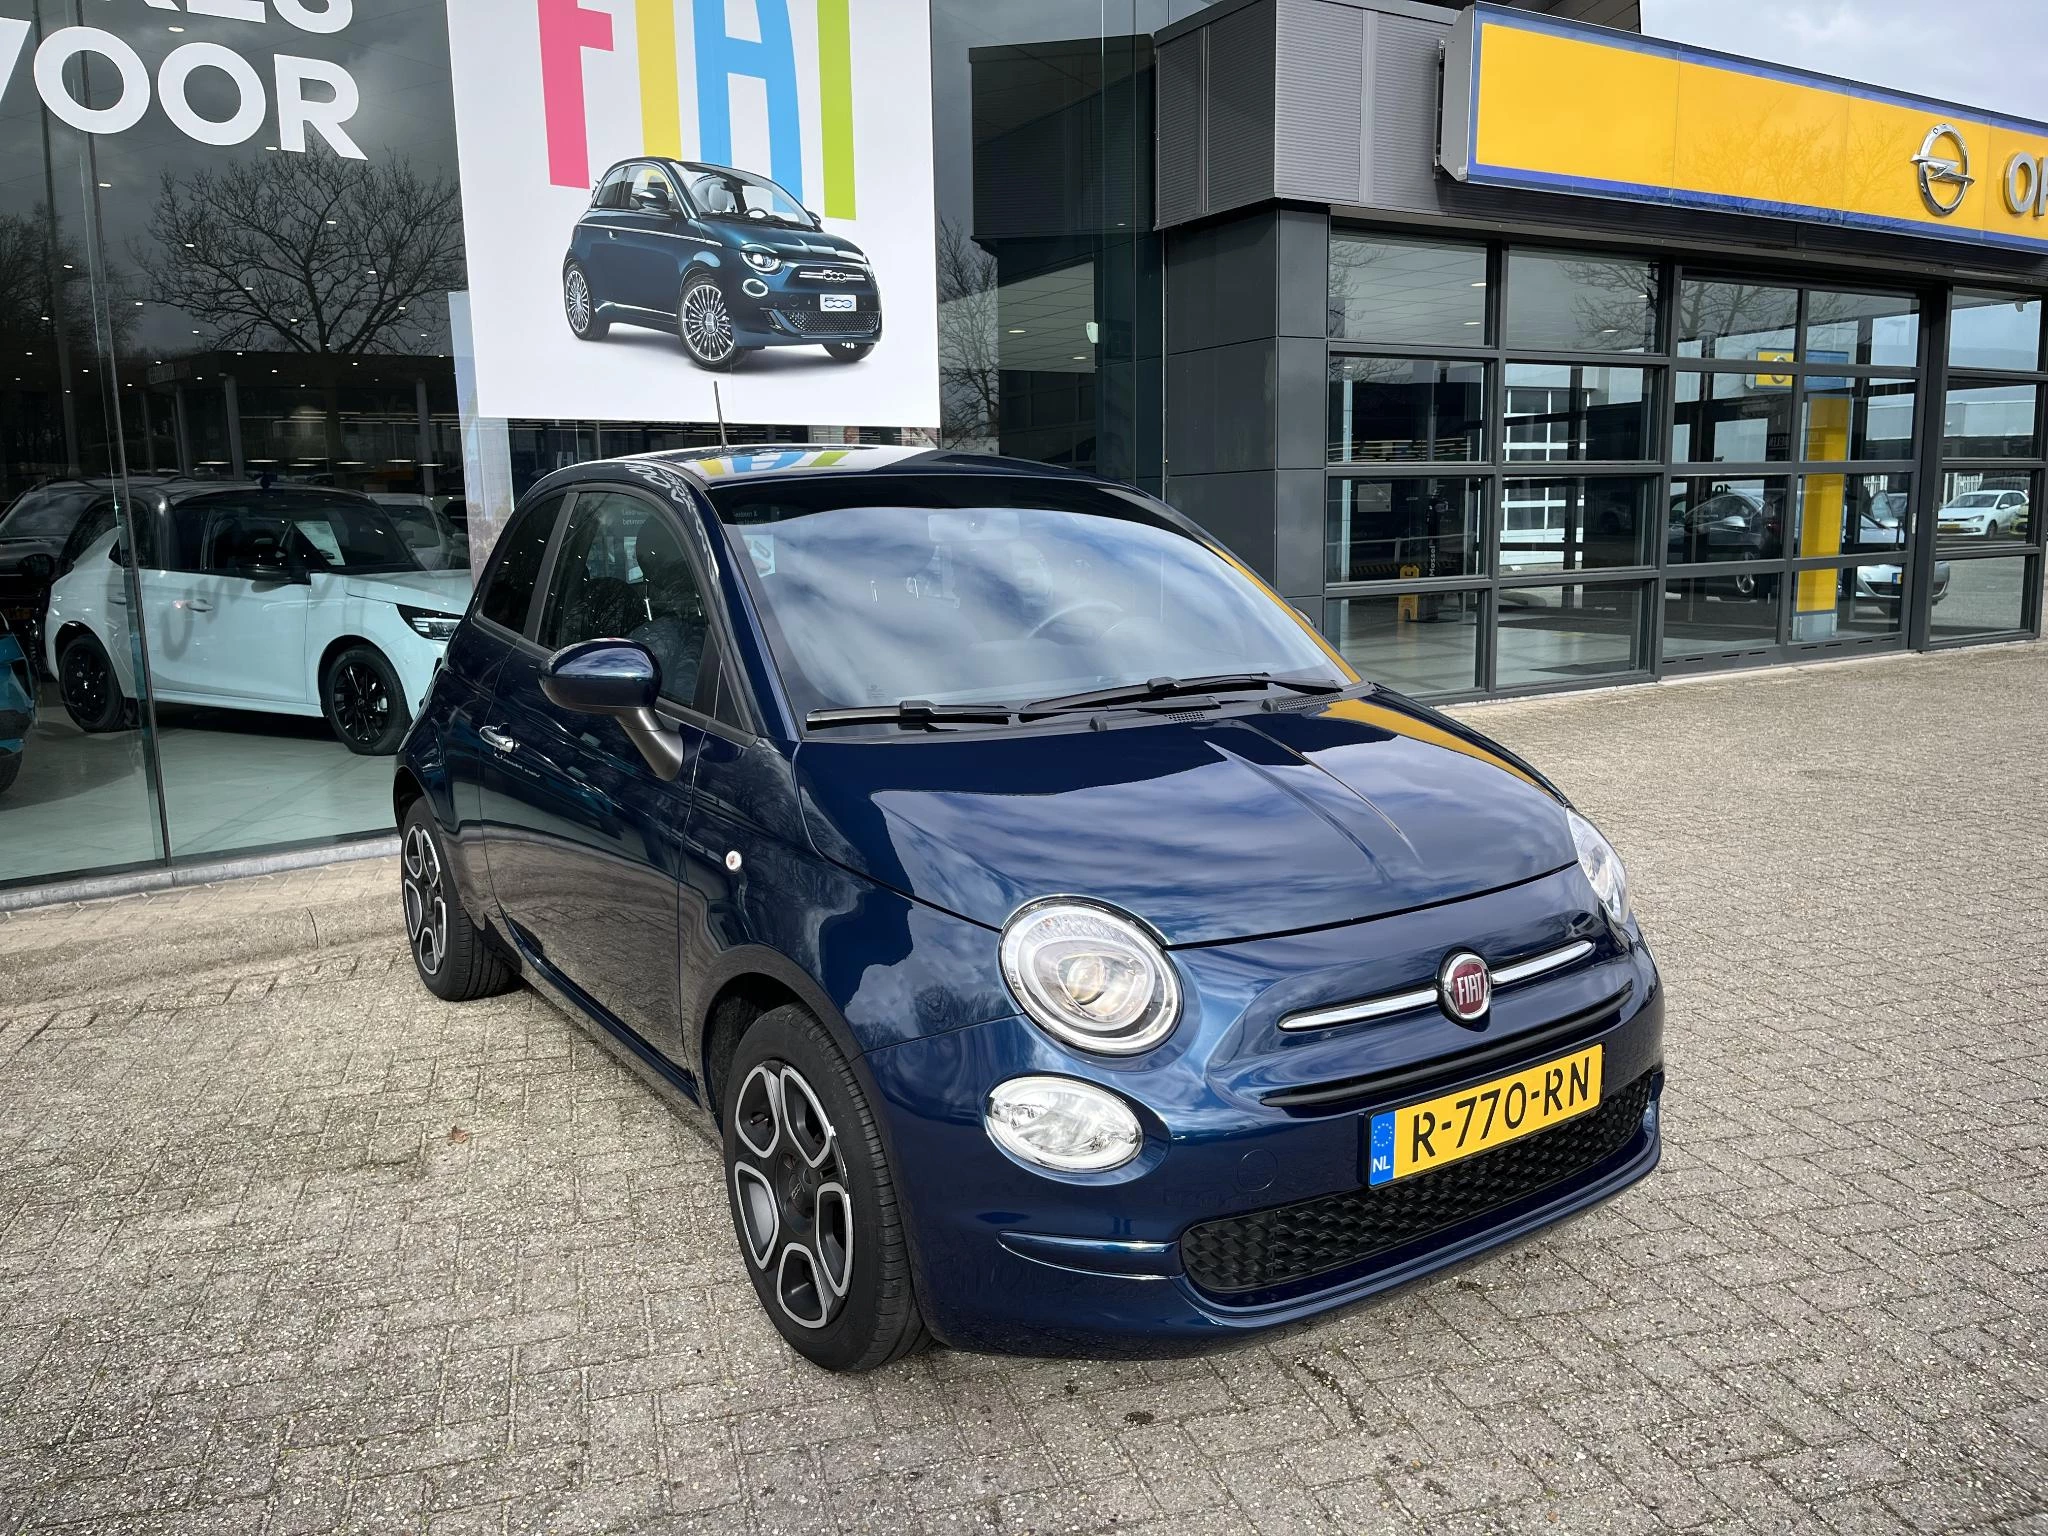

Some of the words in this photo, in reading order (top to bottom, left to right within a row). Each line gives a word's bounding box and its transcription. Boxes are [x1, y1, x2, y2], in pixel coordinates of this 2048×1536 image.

[1456, 972, 1482, 1005] FIAT
[1373, 1155, 1390, 1172] NL
[1411, 1056, 1590, 1162] R-770-RN
